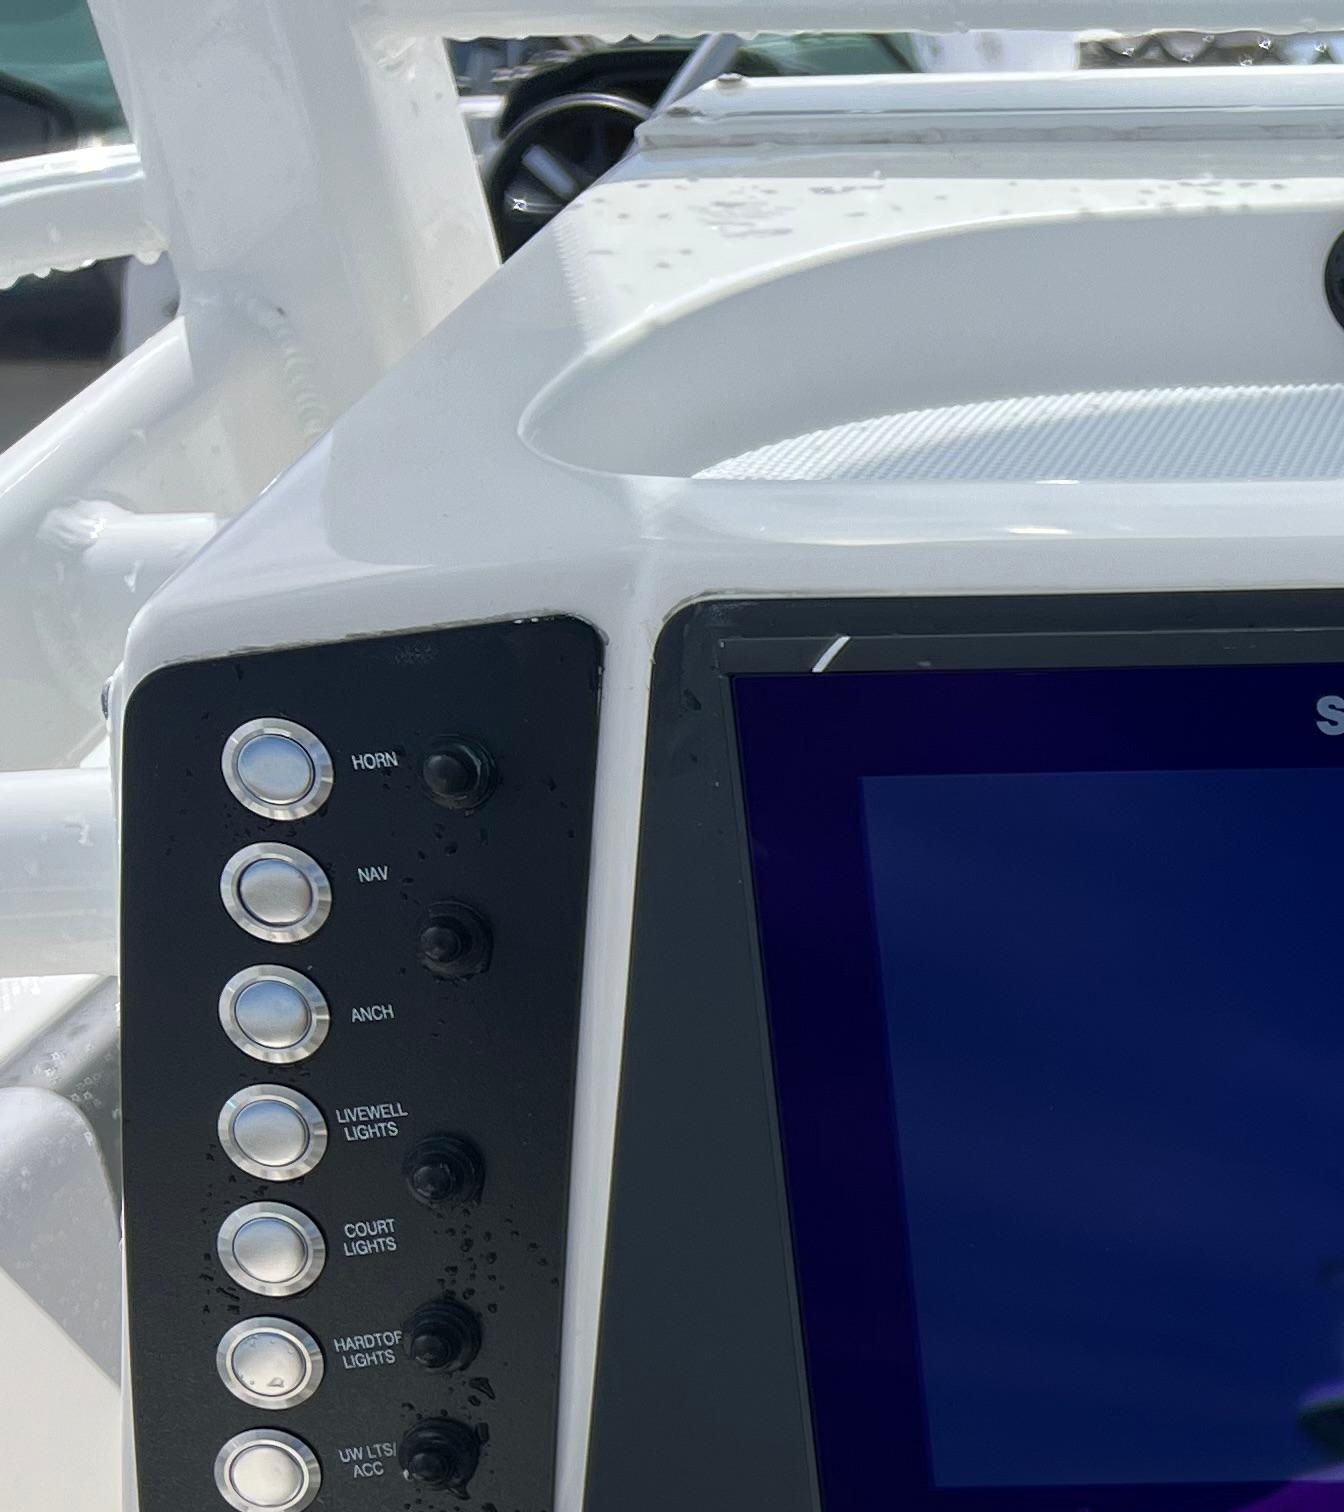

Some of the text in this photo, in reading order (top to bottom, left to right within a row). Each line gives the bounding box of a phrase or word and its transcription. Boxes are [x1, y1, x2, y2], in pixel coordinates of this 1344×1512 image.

[352, 751, 399, 771] HORN
[357, 866, 388, 883] NAV
[351, 1005, 395, 1023] ANCH
[336, 1102, 408, 1123] LIVEWELL
[344, 1121, 398, 1141] LIGHTS
[344, 1218, 394, 1238] COURT
[343, 1237, 396, 1256] LIGHTS
[342, 1349, 395, 1369] LIGHTS
[339, 1446, 362, 1463] UW
[353, 1461, 384, 1478] ACC
